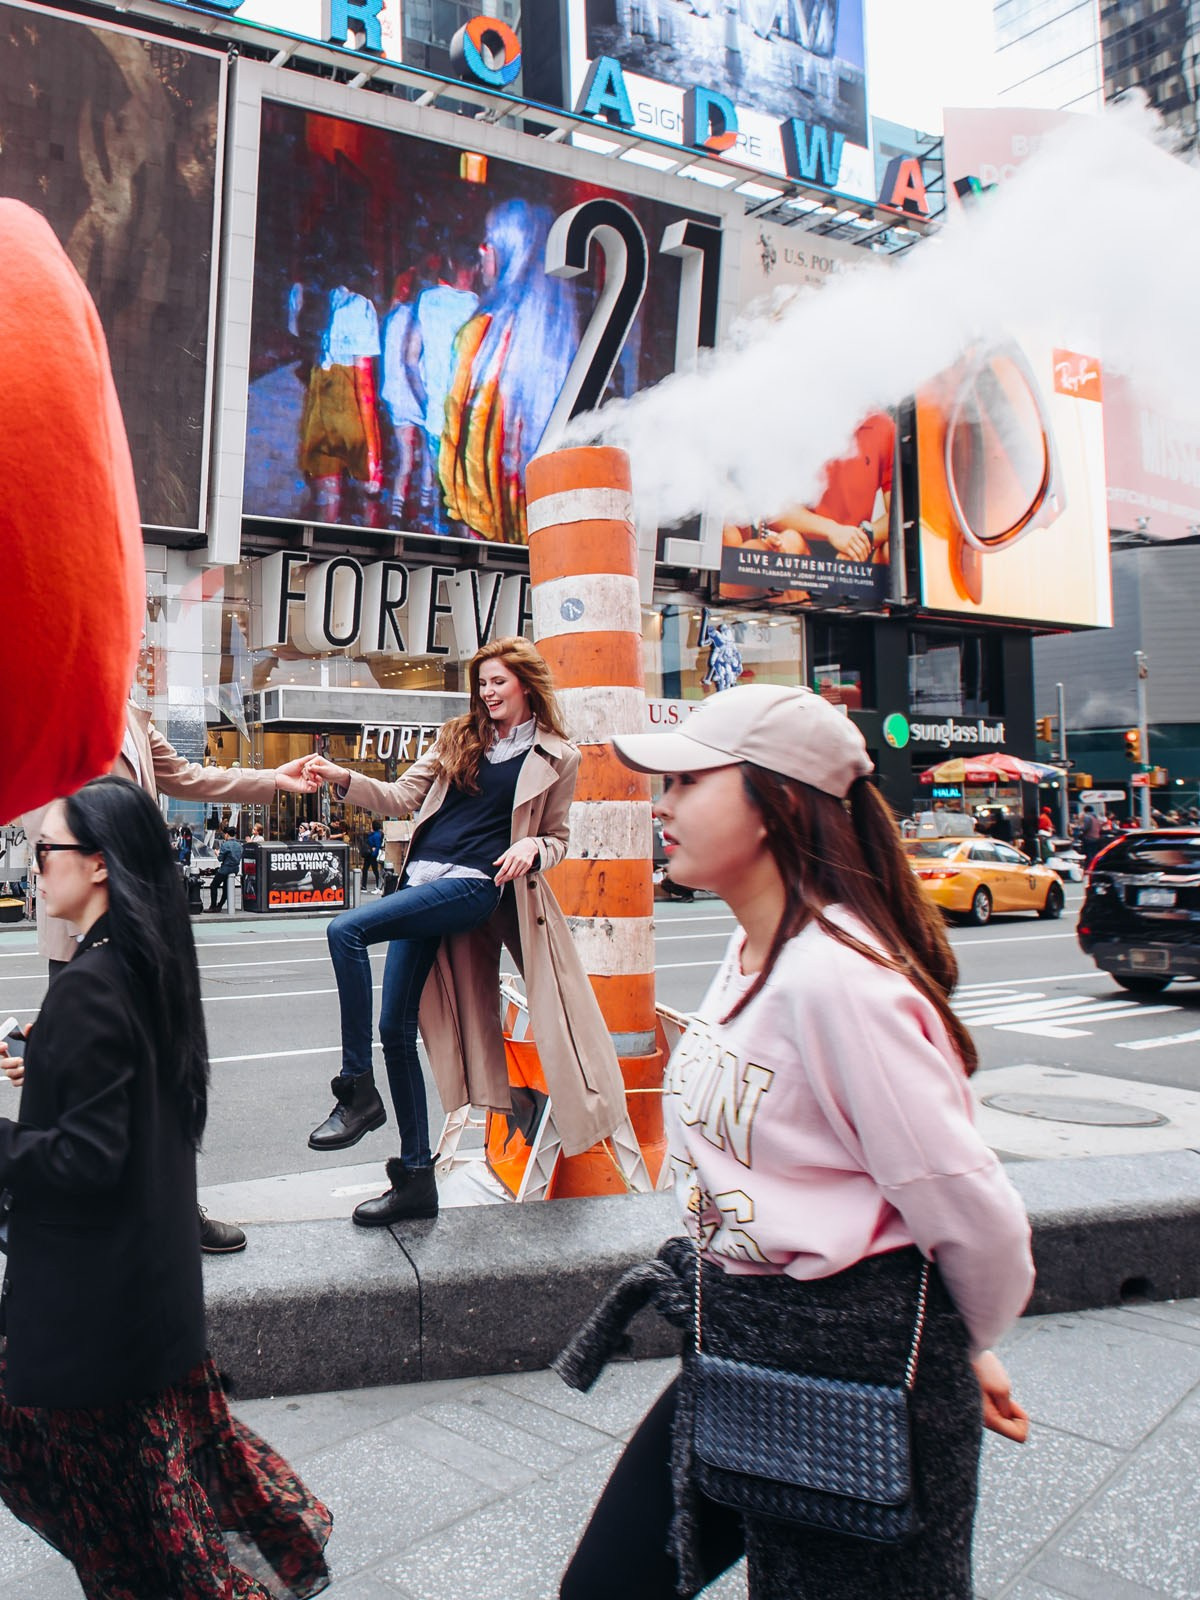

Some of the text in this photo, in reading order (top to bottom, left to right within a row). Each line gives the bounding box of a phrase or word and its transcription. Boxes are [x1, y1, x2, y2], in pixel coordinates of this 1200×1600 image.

[784, 248, 808, 268] U.S.
[739, 552, 873, 577] LIVE AUTHENTICALLY
[648, 704, 683, 725] U.S.
[360, 725, 440, 760] FORE
[910, 718, 1006, 748] sunglass hut
[932, 788, 962, 798] HALAL
[270, 852, 333, 862] BROADWAY'S
[270, 861, 329, 871] SURE THING
[268, 888, 344, 905] CHICAGO
